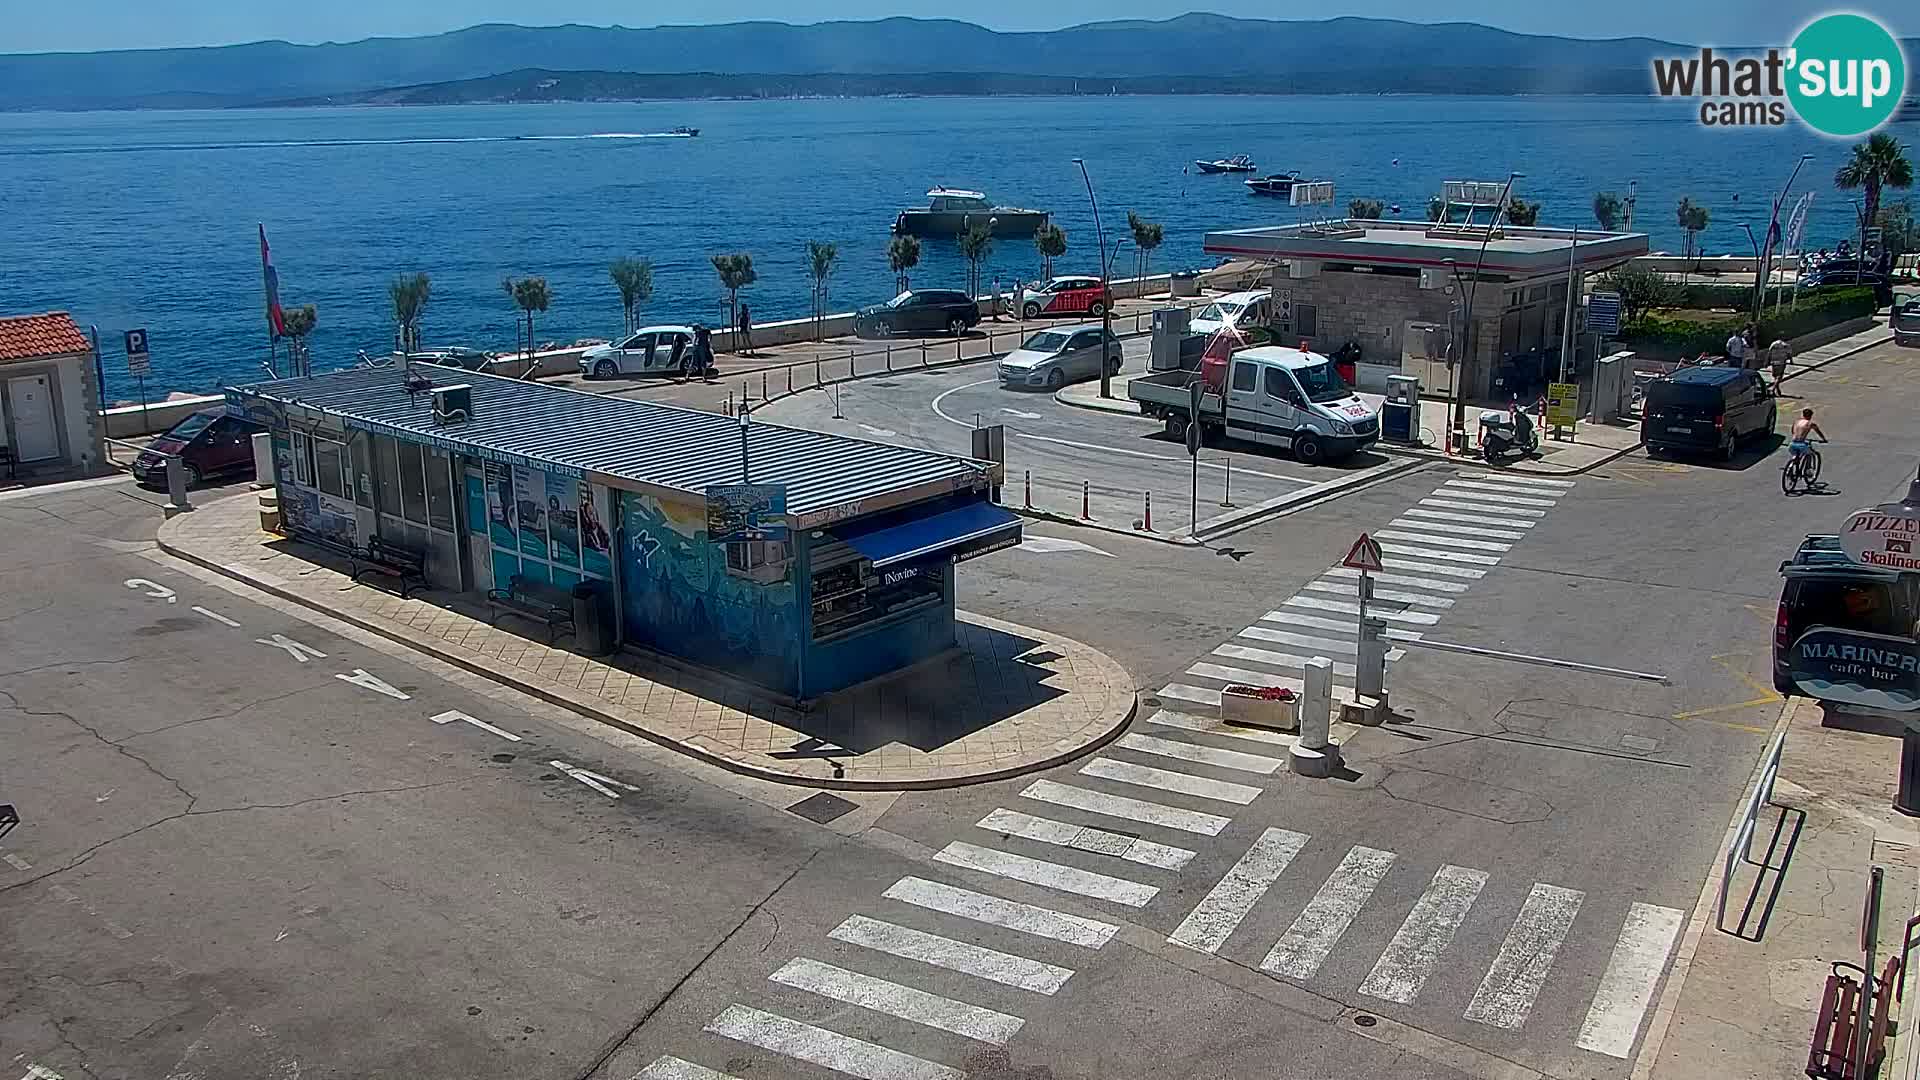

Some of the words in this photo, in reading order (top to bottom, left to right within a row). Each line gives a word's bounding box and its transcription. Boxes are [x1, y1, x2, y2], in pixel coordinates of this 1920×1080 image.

[130, 333, 142, 351] P
[436, 439, 467, 452] POSTAJA
[478, 447, 493, 459] BUS
[494, 452, 526, 466] STATION
[528, 458, 553, 473] TICKET
[555, 464, 583, 478] OFFICE
[1848, 516, 1920, 534] PIZZE
[1882, 531, 1916, 541] GRILL
[1801, 643, 1920, 674] MARINER
[1829, 663, 1866, 675] caffe
[1871, 666, 1899, 681] bar
